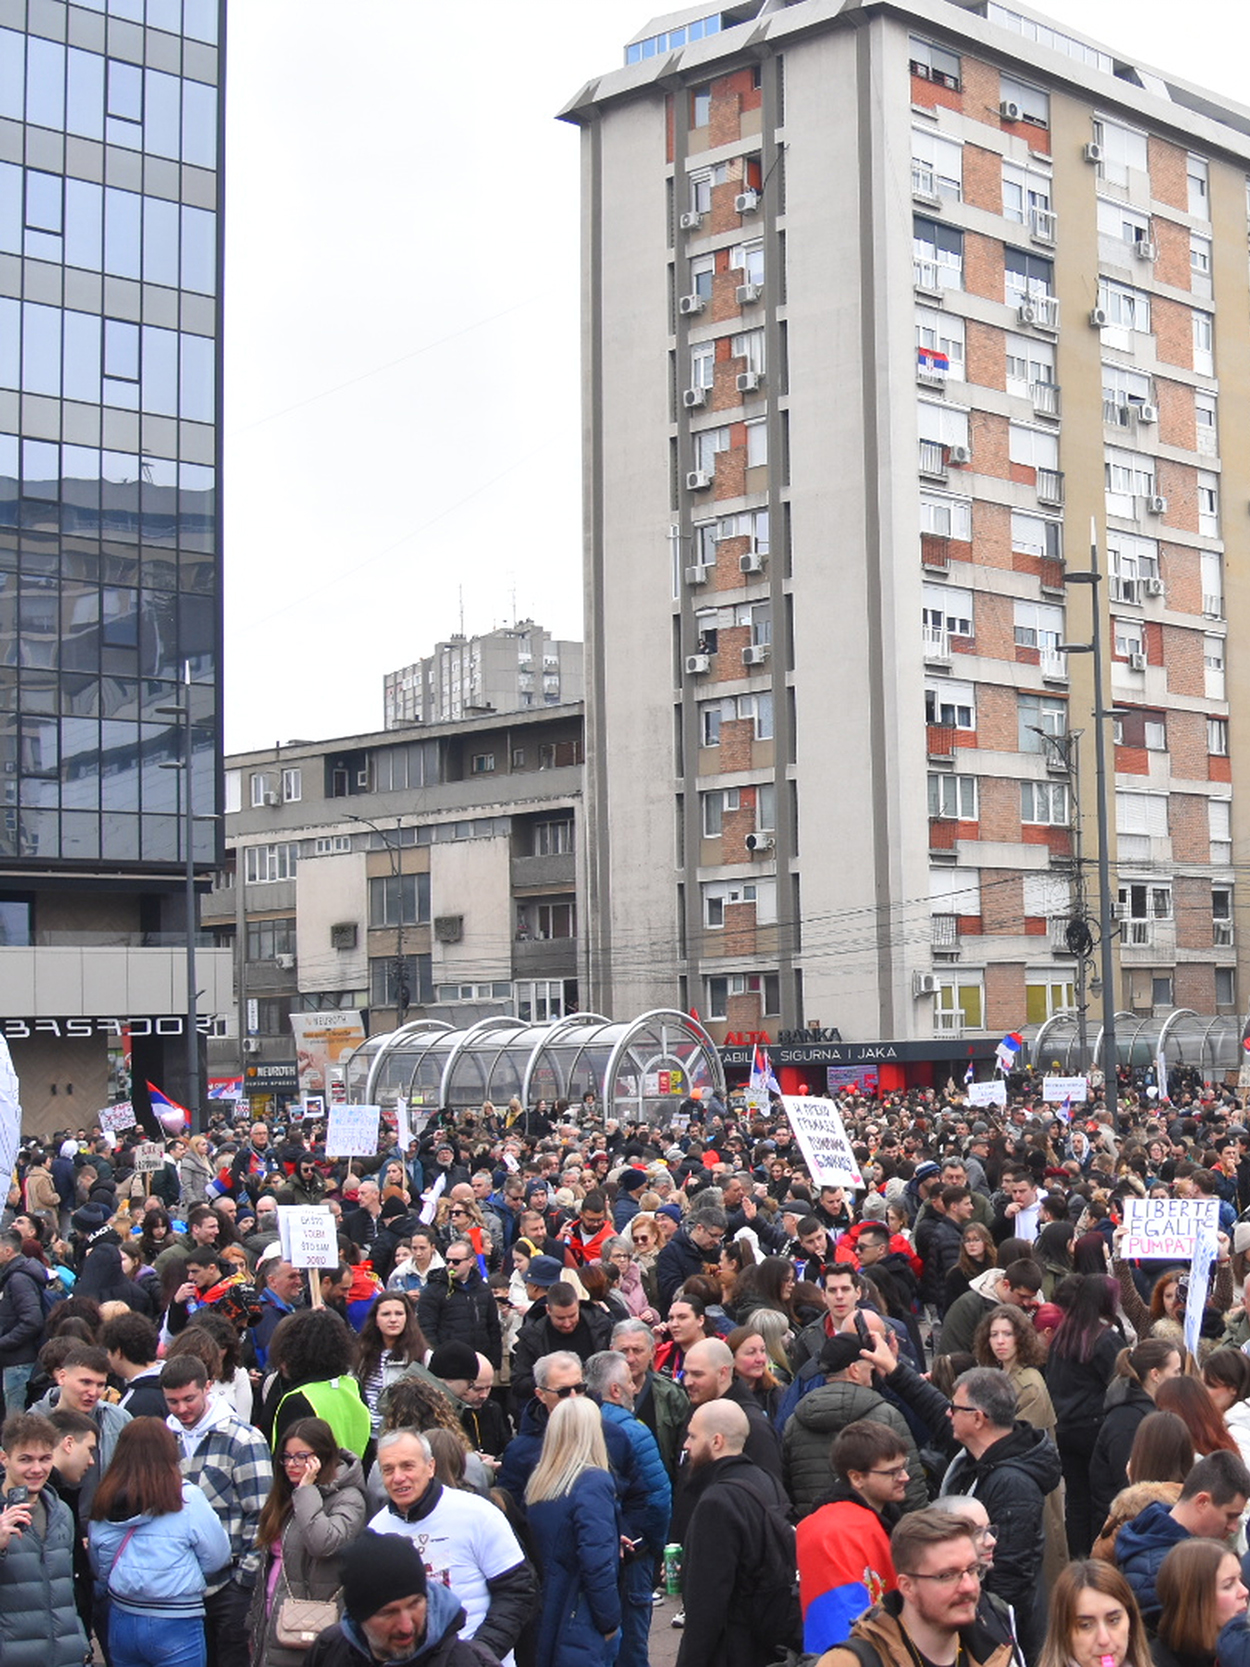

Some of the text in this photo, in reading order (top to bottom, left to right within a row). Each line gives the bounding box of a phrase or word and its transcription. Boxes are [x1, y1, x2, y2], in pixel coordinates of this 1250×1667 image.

[724, 1028, 842, 1045] ALTA BANKA
[780, 1049, 842, 1062] SIGURNA
[857, 1047, 897, 1059] JAKA
[257, 1066, 296, 1077] NEUROTH
[1132, 1200, 1216, 1218] LIBERTE
[1129, 1238, 1197, 1255] PUMPAJ
